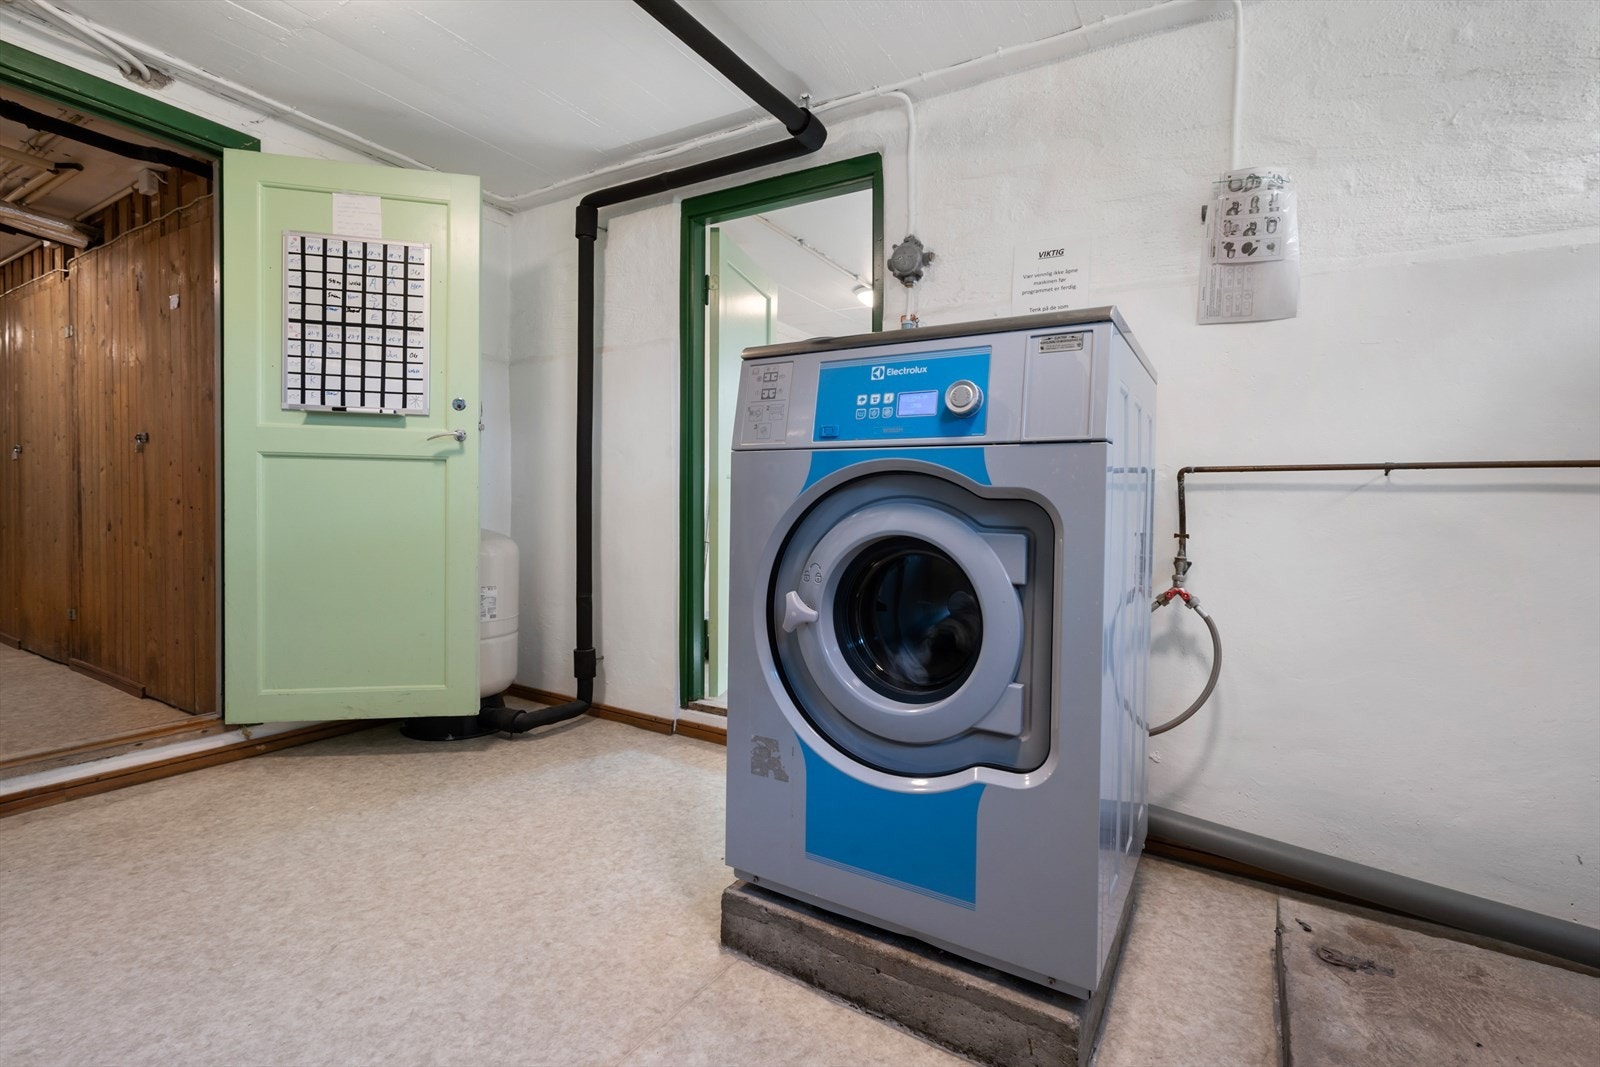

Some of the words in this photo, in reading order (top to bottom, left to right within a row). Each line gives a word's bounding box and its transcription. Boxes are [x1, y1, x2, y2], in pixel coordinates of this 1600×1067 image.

[1038, 248, 1065, 260] VIKTIG
[1065, 267, 1079, 275] åpne
[1033, 278, 1058, 286] maskinen
[1022, 287, 1053, 296] programmet
[1042, 305, 1049, 313] på
[886, 365, 928, 377] Electrolux
